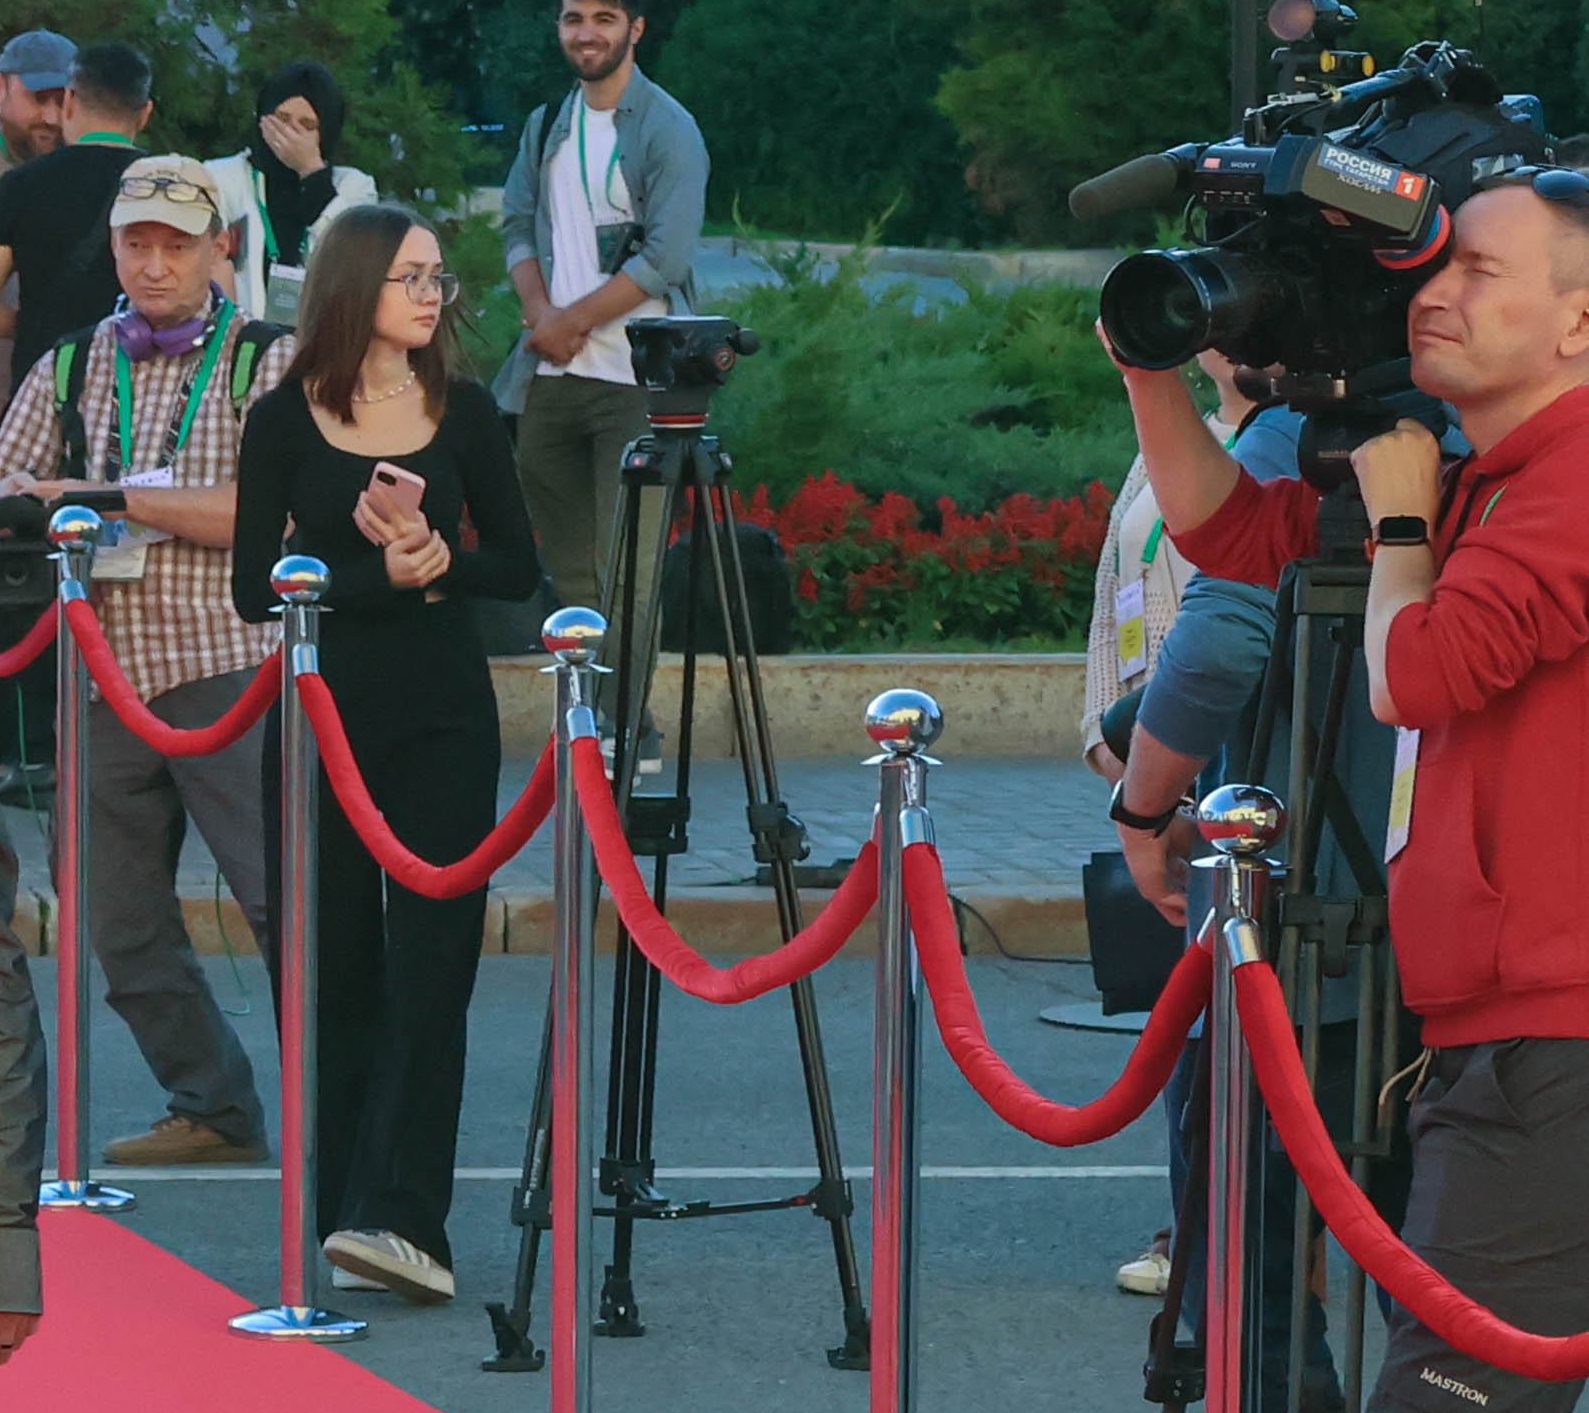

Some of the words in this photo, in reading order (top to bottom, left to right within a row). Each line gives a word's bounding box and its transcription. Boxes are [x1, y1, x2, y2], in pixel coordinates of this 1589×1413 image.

[1326, 147, 1393, 180] РОССИЯ
[1402, 176, 1415, 195] 1
[1419, 1367, 1489, 1407] MASTRON
